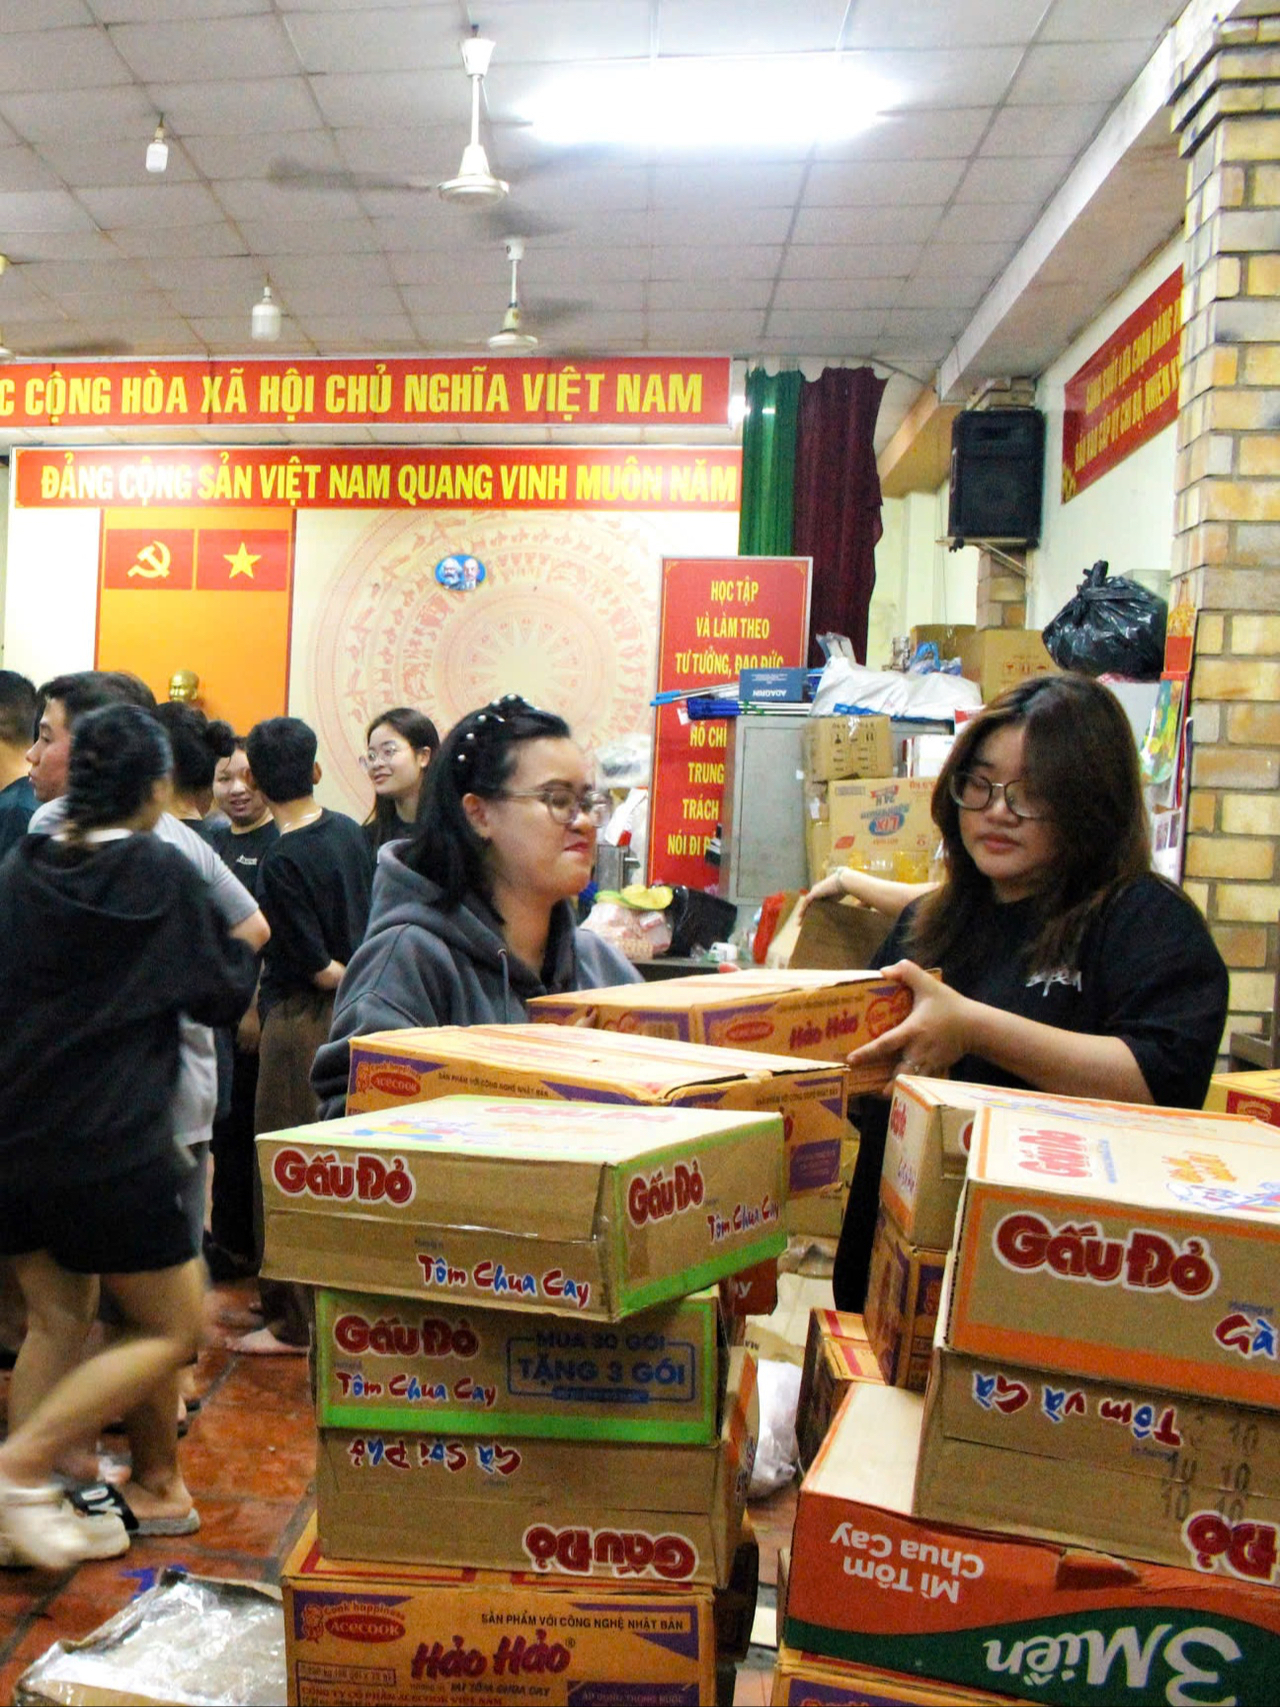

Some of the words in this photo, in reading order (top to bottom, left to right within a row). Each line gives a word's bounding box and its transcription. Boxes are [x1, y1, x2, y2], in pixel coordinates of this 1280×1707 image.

[25, 371, 111, 424] CỘNG
[121, 368, 188, 414] HÒA
[201, 367, 247, 414] XÃ
[259, 367, 314, 421] HỘI
[325, 363, 391, 414] CHỦ
[404, 365, 509, 414] NGHĨA
[523, 366, 605, 421] VIỆT
[616, 373, 702, 414] NAM
[41, 452, 113, 499] ĐẢNG
[119, 455, 192, 507] CỘNG
[198, 451, 252, 499] SẢN
[260, 456, 321, 507] VIỆT
[329, 465, 390, 500] NAM
[398, 464, 493, 507] QUANG
[500, 465, 567, 501] VINH
[576, 455, 662, 501] MUÔN
[670, 458, 737, 502] NĂM
[711, 580, 734, 605] HỌC
[737, 575, 759, 606] TẬP
[696, 612, 710, 638] VÀ
[713, 613, 738, 639] LÀM
[740, 617, 770, 639] THEO
[675, 652, 693, 674] TƯ
[693, 645, 732, 679] TƯỞNG,
[690, 719, 706, 748] HỒ
[688, 762, 725, 784] TRUNG
[682, 793, 719, 820] TRÁCH
[668, 828, 687, 856] NÓI
[689, 833, 700, 856] ĐI
[274, 1150, 355, 1198] Gấu
[355, 1158, 412, 1204] Đỏ
[628, 1170, 675, 1225] Gấu
[674, 1160, 704, 1211] Đỏ
[707, 1214, 731, 1242] Tôm
[733, 1204, 759, 1232] Chua
[761, 1195, 780, 1221] Cay
[996, 1213, 1126, 1285] Gấu
[1125, 1231, 1214, 1296] Đỏ
[417, 1254, 467, 1285] Tôm
[473, 1260, 537, 1296] Chua
[542, 1269, 590, 1309] Cay
[335, 1315, 420, 1356] Gấu
[422, 1318, 479, 1358] Đỏ
[536, 1331, 586, 1347] MUA
[1215, 1311, 1275, 1357] Gà
[518, 1352, 599, 1387] TẶNG
[608, 1360, 623, 1383] 3
[336, 1371, 382, 1397] Tôm
[389, 1374, 447, 1401] Chua
[454, 1377, 496, 1407] Cay
[974, 1373, 1029, 1414] Gà
[1042, 1386, 1085, 1422] và
[1100, 1399, 1182, 1448] Tôm
[348, 1438, 412, 1470] Phở
[419, 1437, 468, 1472] Sợi
[476, 1444, 521, 1475] Gà
[524, 1525, 594, 1572] Đỏ
[595, 1531, 698, 1580] Gấu
[831, 1522, 893, 1558] Cay
[1186, 1513, 1278, 1582] Đỏ
[843, 1556, 913, 1592] Tôm
[901, 1539, 984, 1580] Chua
[920, 1575, 960, 1604] Mì
[482, 1610, 505, 1625] SẢN
[506, 1610, 537, 1626] PHẨM
[538, 1612, 558, 1627] VỚI
[559, 1611, 591, 1629] CÔNG
[593, 1615, 624, 1631] NGHỆ
[627, 1616, 657, 1631] NHẬT
[660, 1617, 684, 1631] BẢN
[412, 1634, 487, 1680] Hảo
[493, 1628, 571, 1675] Hảo
[985, 1624, 1173, 1688] Miền
[1163, 1627, 1243, 1705] 3
